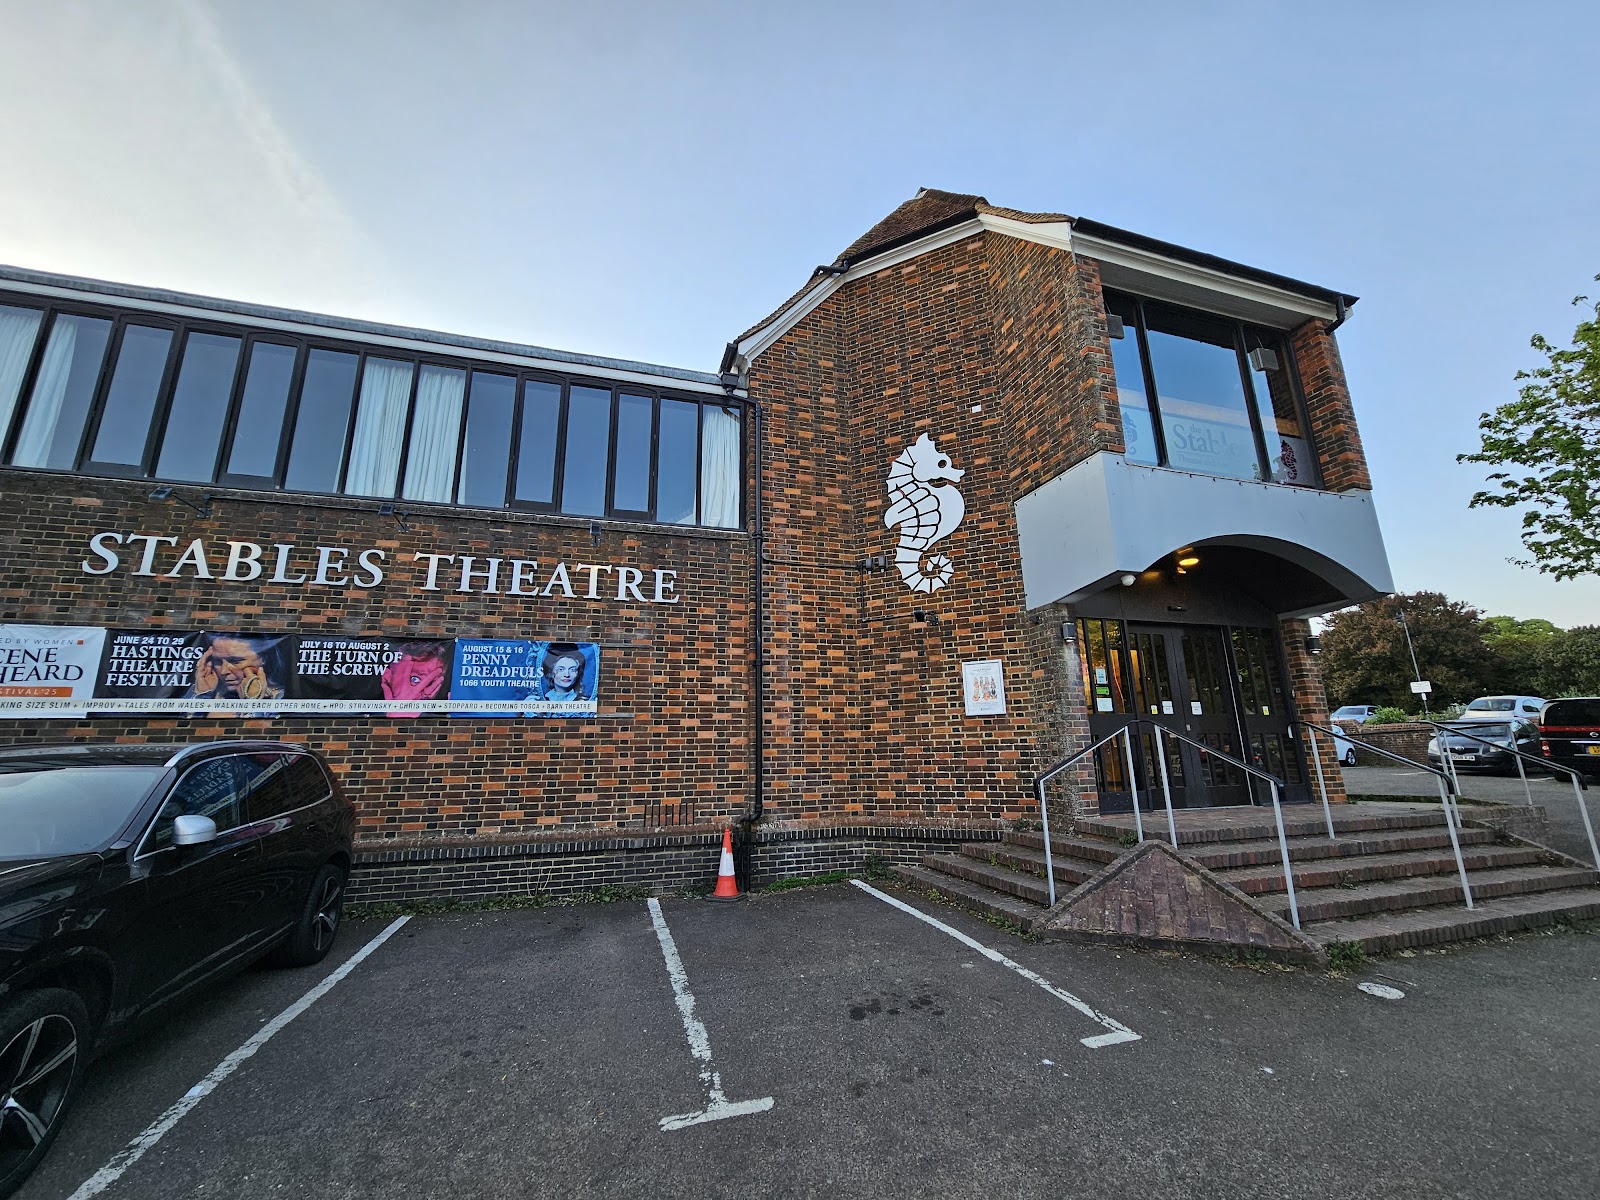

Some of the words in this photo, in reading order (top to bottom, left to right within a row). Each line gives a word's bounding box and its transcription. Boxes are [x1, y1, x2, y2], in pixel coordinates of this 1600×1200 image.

[1190, 424, 1201, 433] the
[81, 531, 386, 588] STABLES
[413, 551, 681, 604] THEATRE
[114, 636, 140, 644] JUNE
[157, 637, 169, 645] TO
[348, 642, 382, 650] AUGUST
[111, 645, 203, 659] HASTINGS
[299, 650, 331, 662] THE
[335, 650, 380, 663] TURN
[382, 651, 403, 663] OF
[110, 659, 194, 672] THEATRE
[462, 654, 511, 665] PENNY
[297, 662, 330, 674] THE
[332, 663, 388, 676] SCREW
[460, 666, 544, 678] DREADFULS
[105, 673, 191, 687] FESTIVAL
